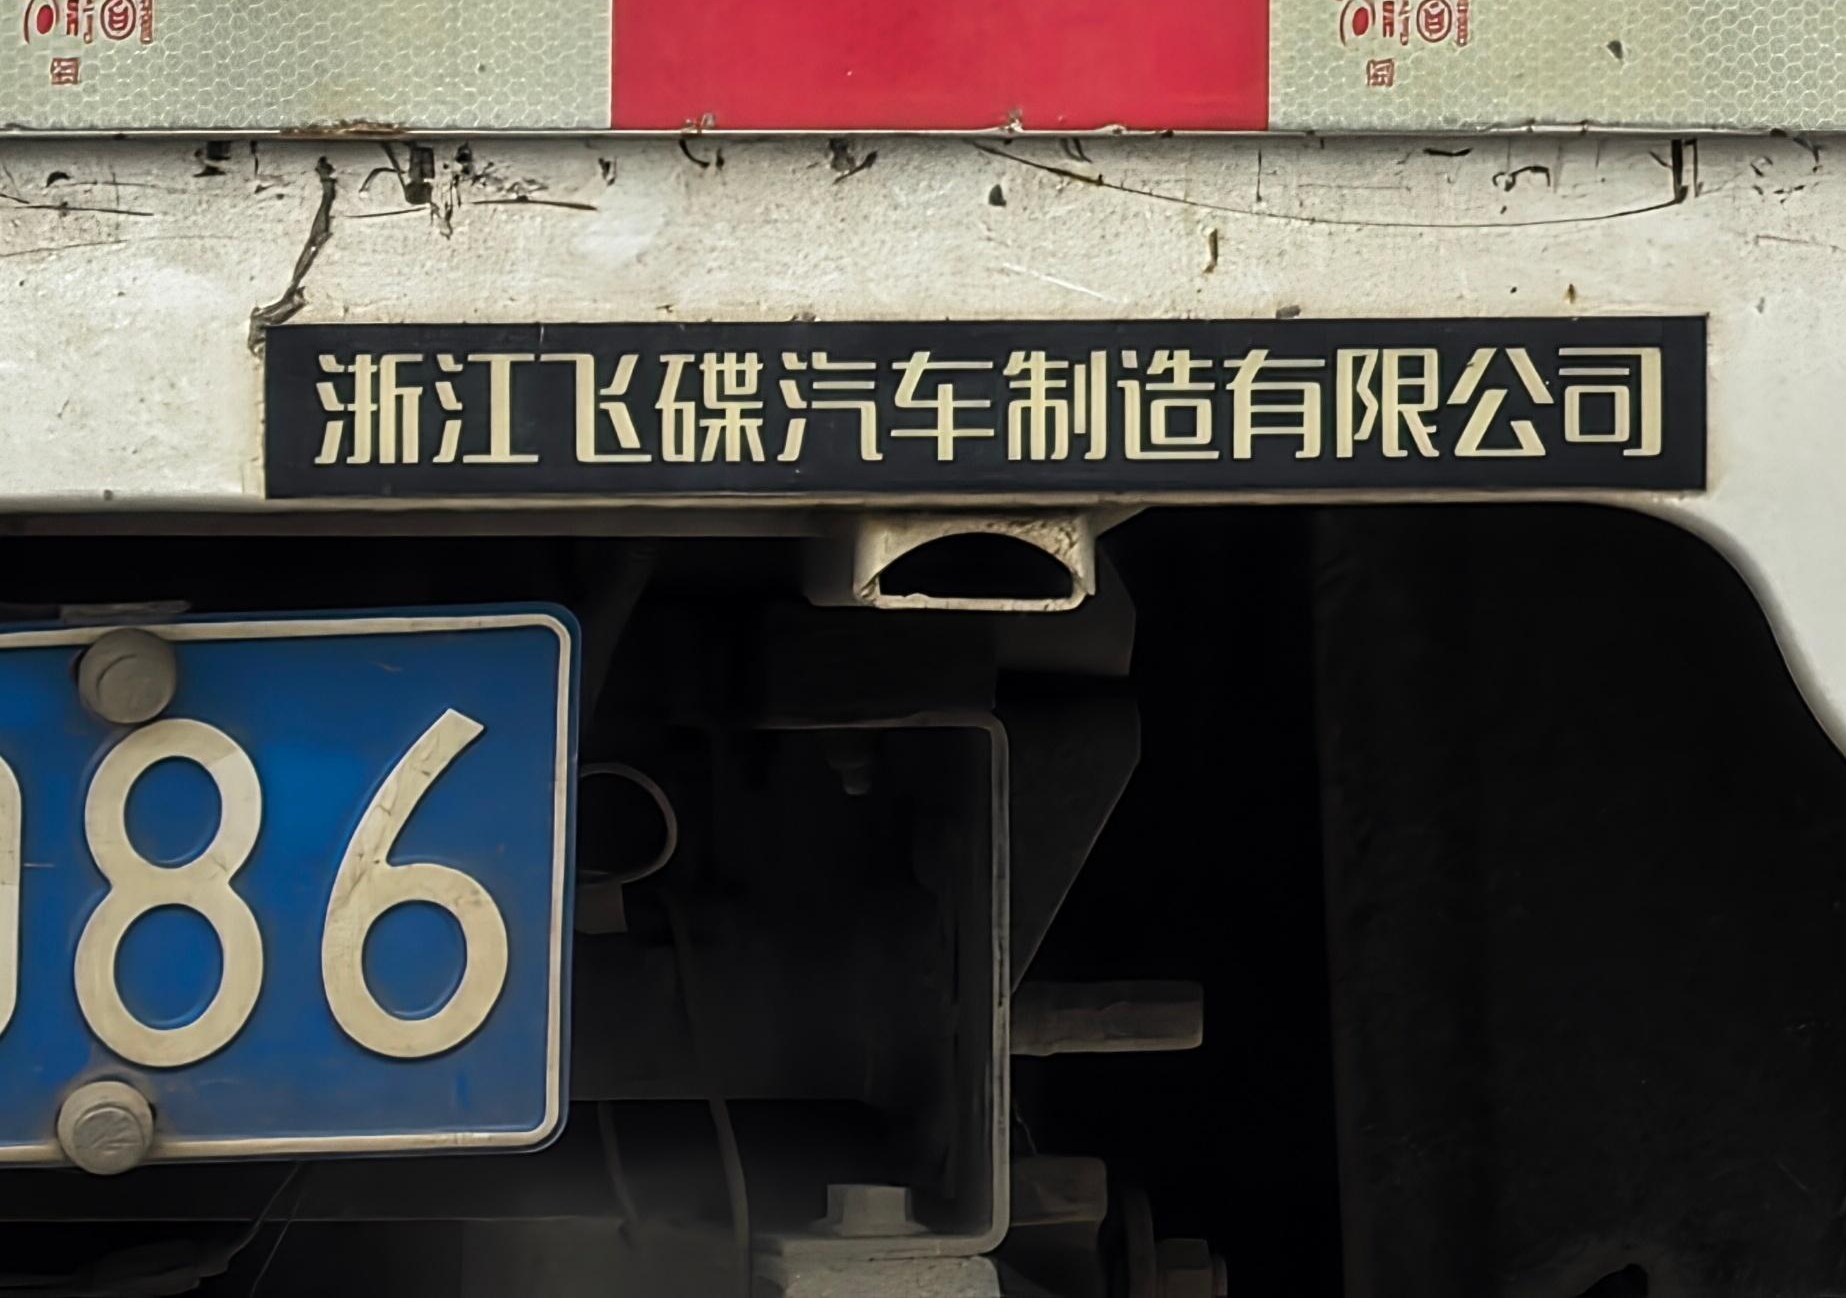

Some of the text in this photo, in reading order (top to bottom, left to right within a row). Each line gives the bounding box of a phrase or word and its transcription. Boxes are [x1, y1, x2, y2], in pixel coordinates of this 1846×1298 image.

[314, 347, 1662, 464] 浙江飞碟汽车制造有限公司
[0, 708, 509, 1068] 86
